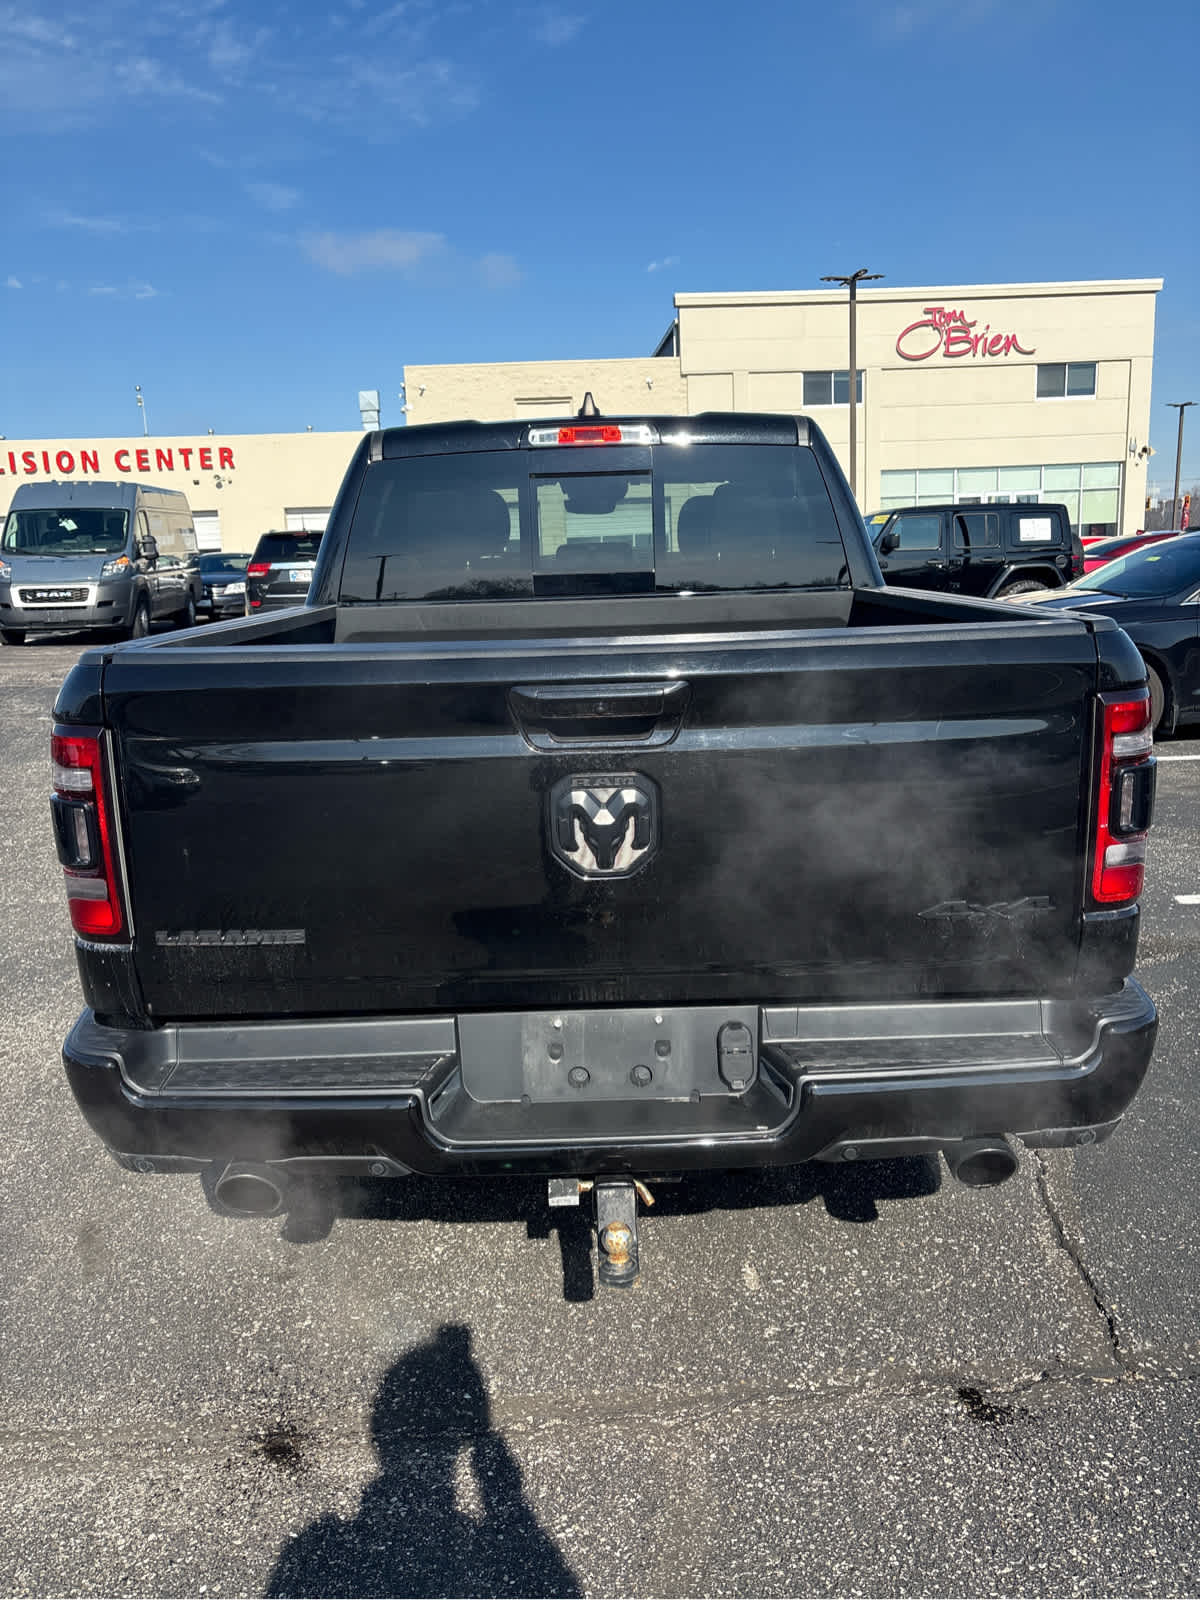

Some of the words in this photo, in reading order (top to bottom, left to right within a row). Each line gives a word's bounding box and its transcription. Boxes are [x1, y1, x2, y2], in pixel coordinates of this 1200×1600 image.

[923, 306, 977, 328] Tom
[114, 447, 235, 471] CENTER
[571, 776, 634, 786] RAM
